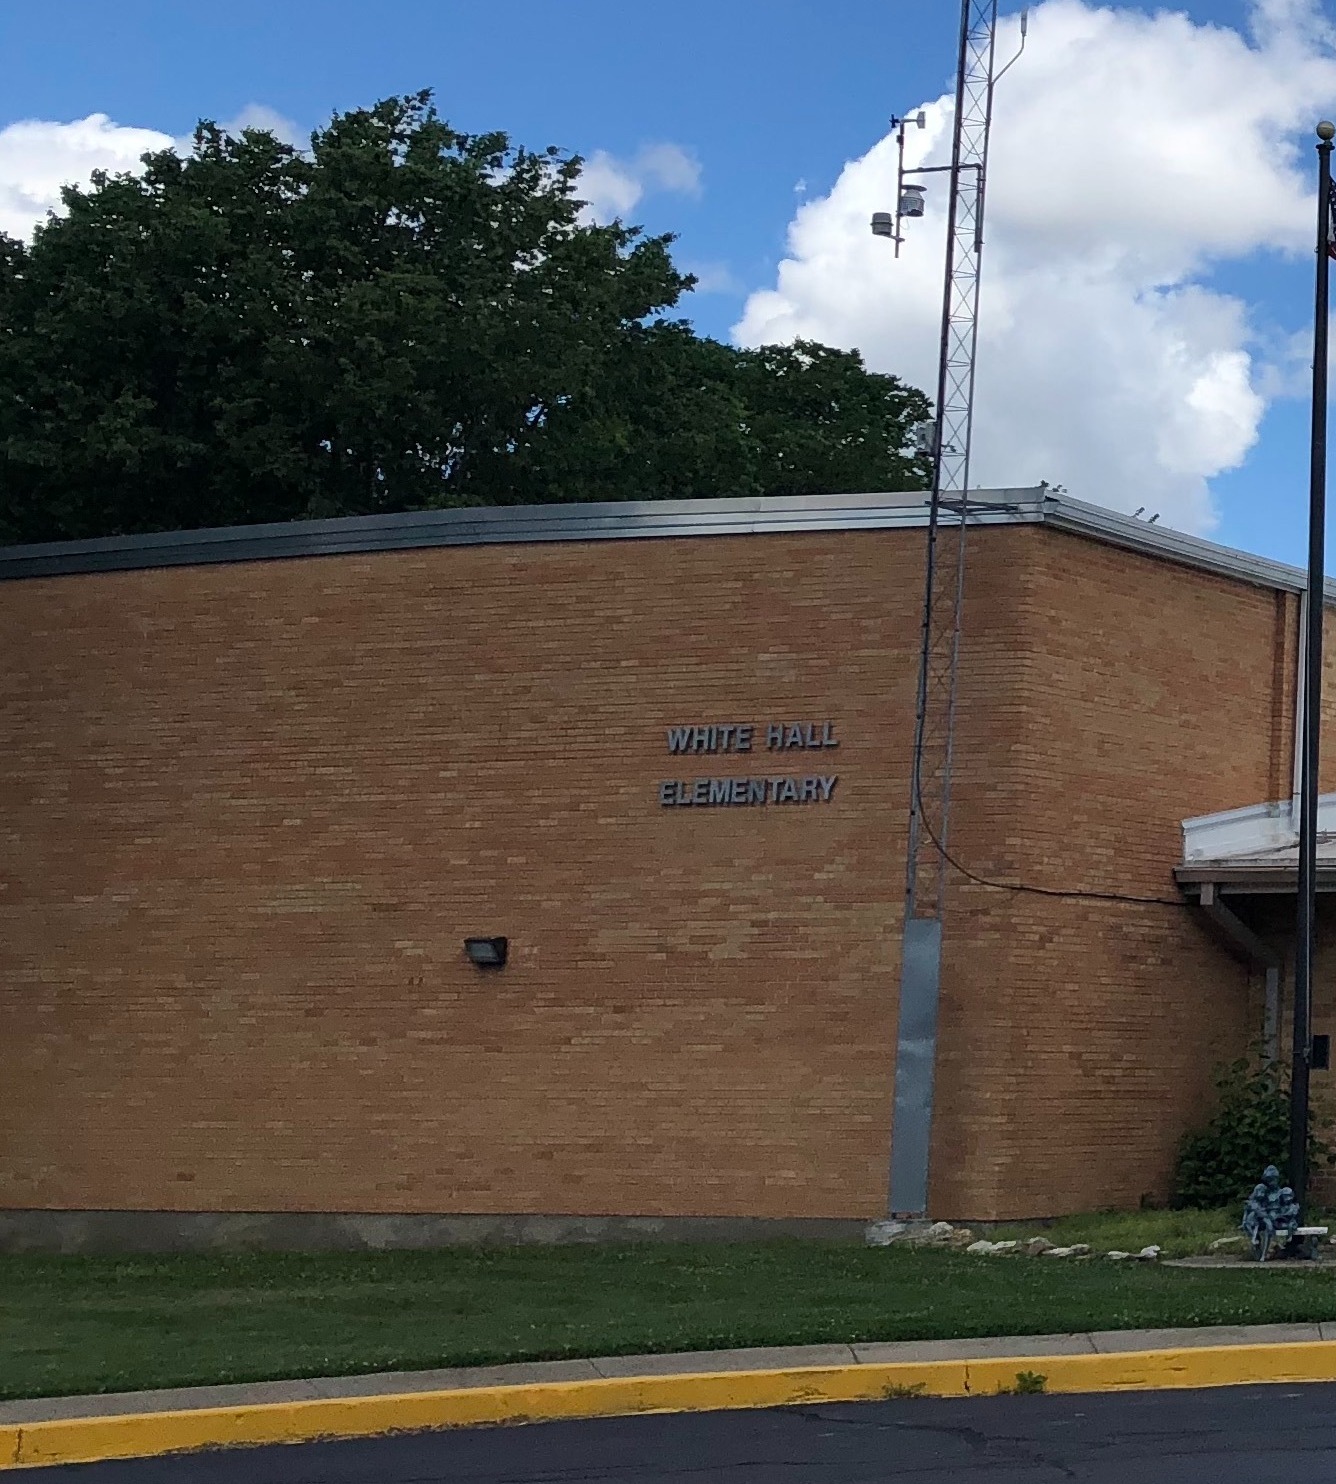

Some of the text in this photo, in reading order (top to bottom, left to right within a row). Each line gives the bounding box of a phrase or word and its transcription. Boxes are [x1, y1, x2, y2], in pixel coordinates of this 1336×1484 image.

[667, 721, 840, 753] WHITE HALL
[660, 774, 838, 805] ELEMENTARY
